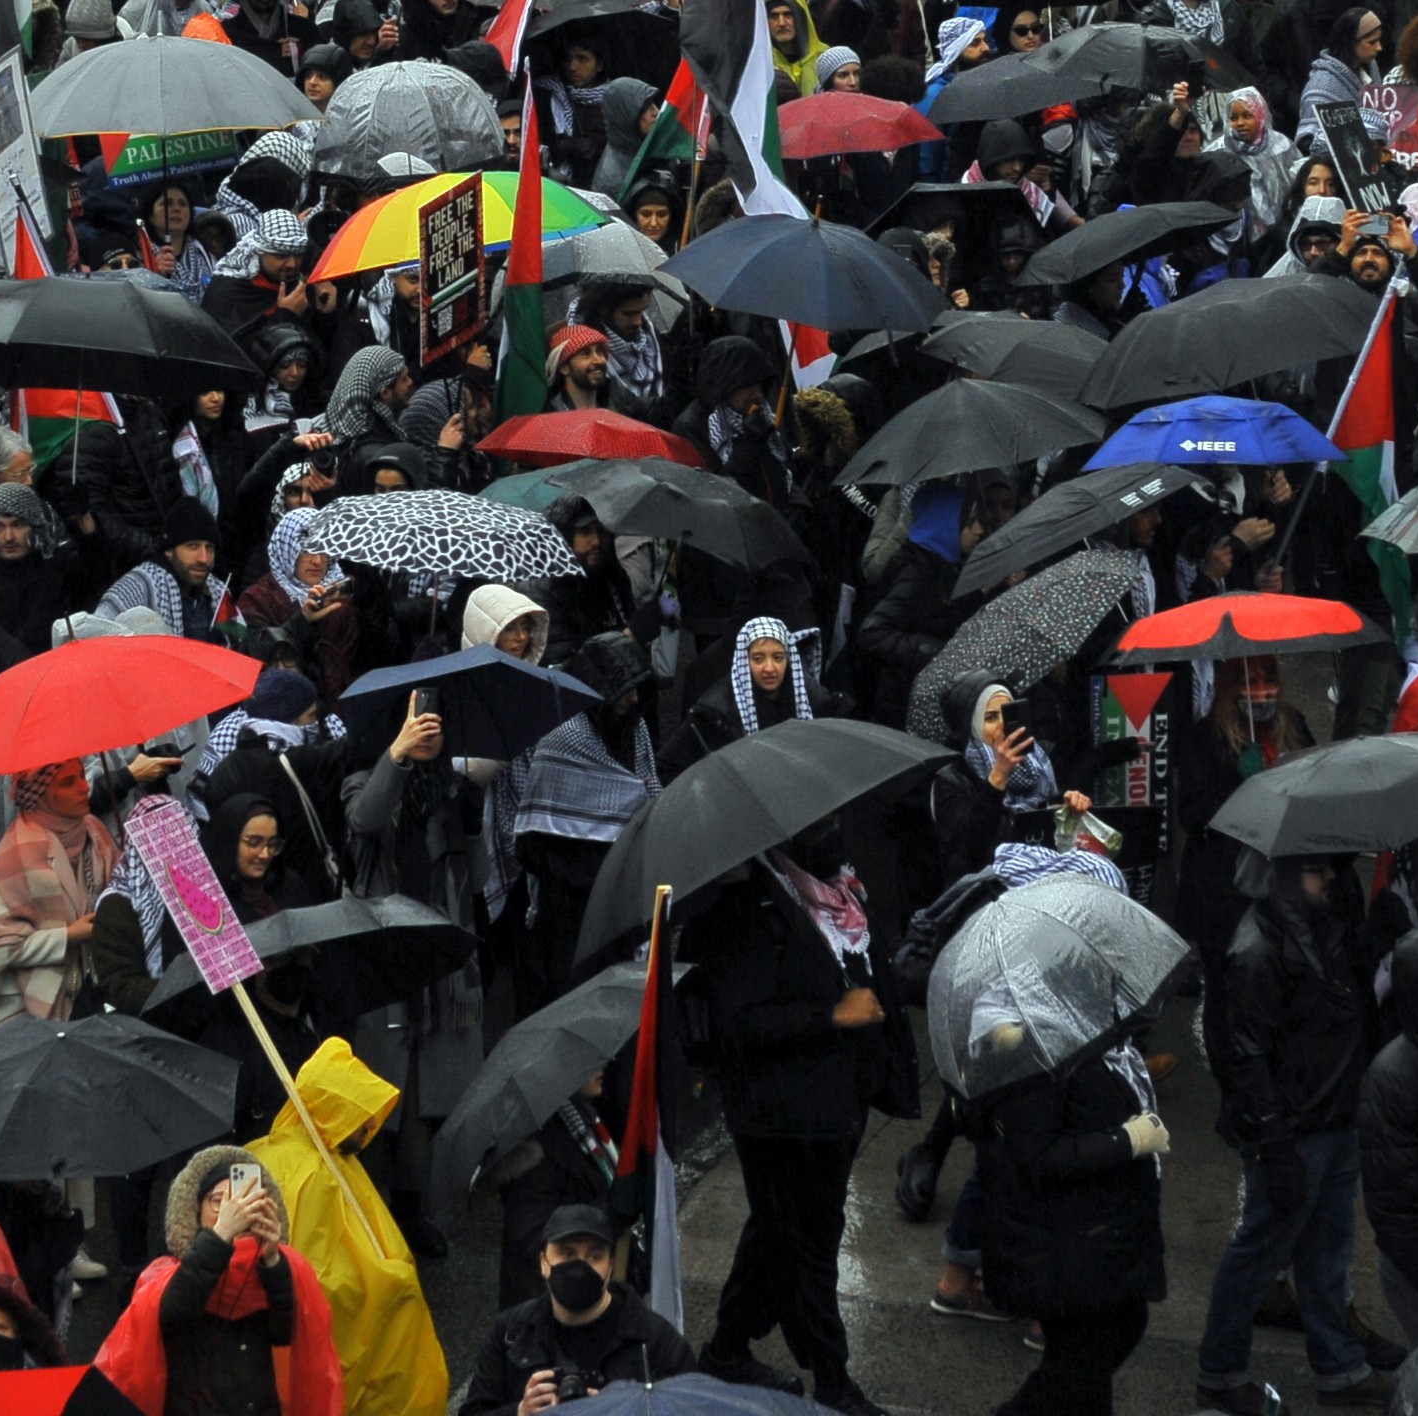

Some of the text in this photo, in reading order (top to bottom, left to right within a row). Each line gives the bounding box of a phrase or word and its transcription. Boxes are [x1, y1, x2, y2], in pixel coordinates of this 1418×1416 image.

[1362, 87, 1398, 111] NO
[125, 131, 234, 166] PALESTINE
[428, 189, 475, 234] FREE THE
[1360, 182, 1392, 214] NOW
[428, 231, 476, 273] FREE THE
[438, 259, 466, 288] LAND
[1197, 441, 1236, 452] IEEE
[1154, 712, 1169, 781] END
